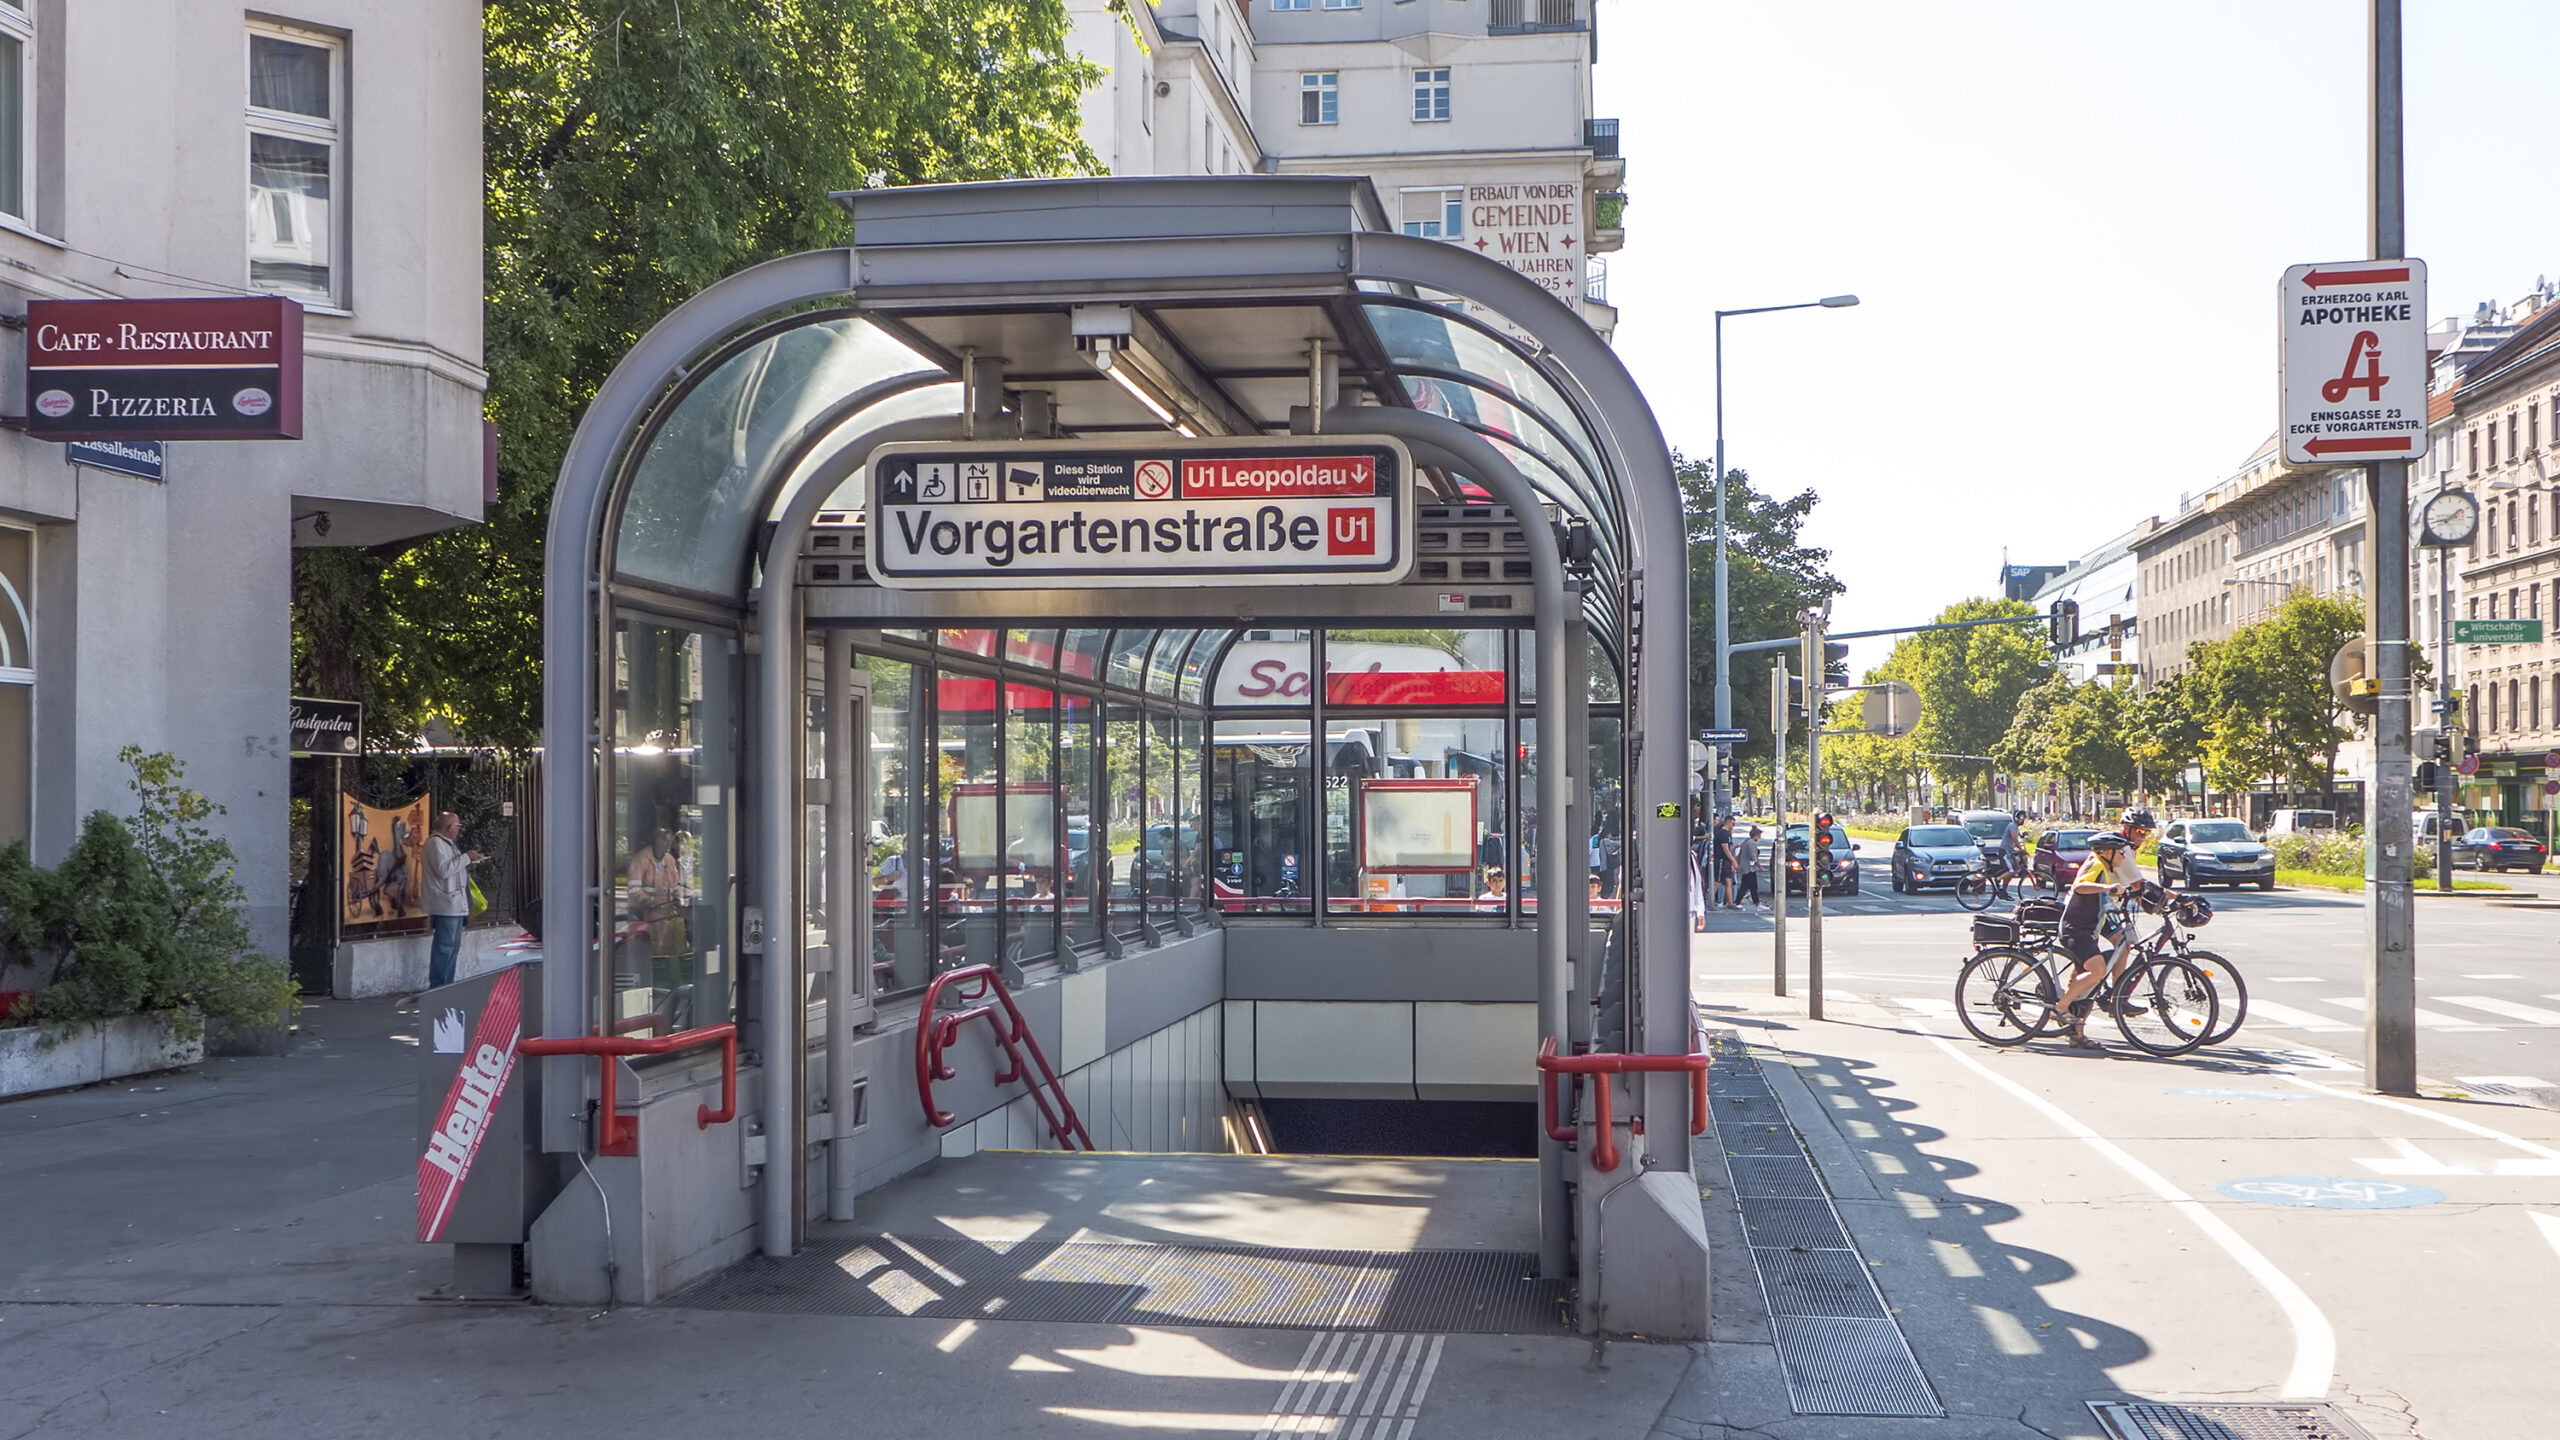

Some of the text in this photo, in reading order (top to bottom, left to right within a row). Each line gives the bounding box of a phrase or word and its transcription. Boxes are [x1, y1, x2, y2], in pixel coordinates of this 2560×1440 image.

[1470, 184, 1574, 201] ERBAUT VON DER
[1472, 204, 1574, 227] GEMEINDE
[1499, 232, 1549, 254] WIEN
[1517, 258, 1574, 273] JAHREN
[2301, 291, 2409, 305] ERZHERZOG KARL
[2300, 304, 2411, 326] APOTHEKE
[2311, 409, 2401, 421] ENNSGASSE 23
[2290, 419, 2423, 434] ECKE VORGARTENSTR.
[1054, 463, 1123, 475] Diese Station
[1187, 462, 1347, 490] U1 Leopoldau
[1077, 475, 1101, 485] wird
[1048, 485, 1130, 496] videoüberwacht
[895, 505, 1321, 567] Vorgartenstraße
[1334, 516, 1369, 544] U1
[2010, 567, 2031, 577] SAP
[2470, 622, 2527, 631] Wirtschafts-
[2473, 632, 2524, 642] universität
[425, 1043, 506, 1178] Heute
